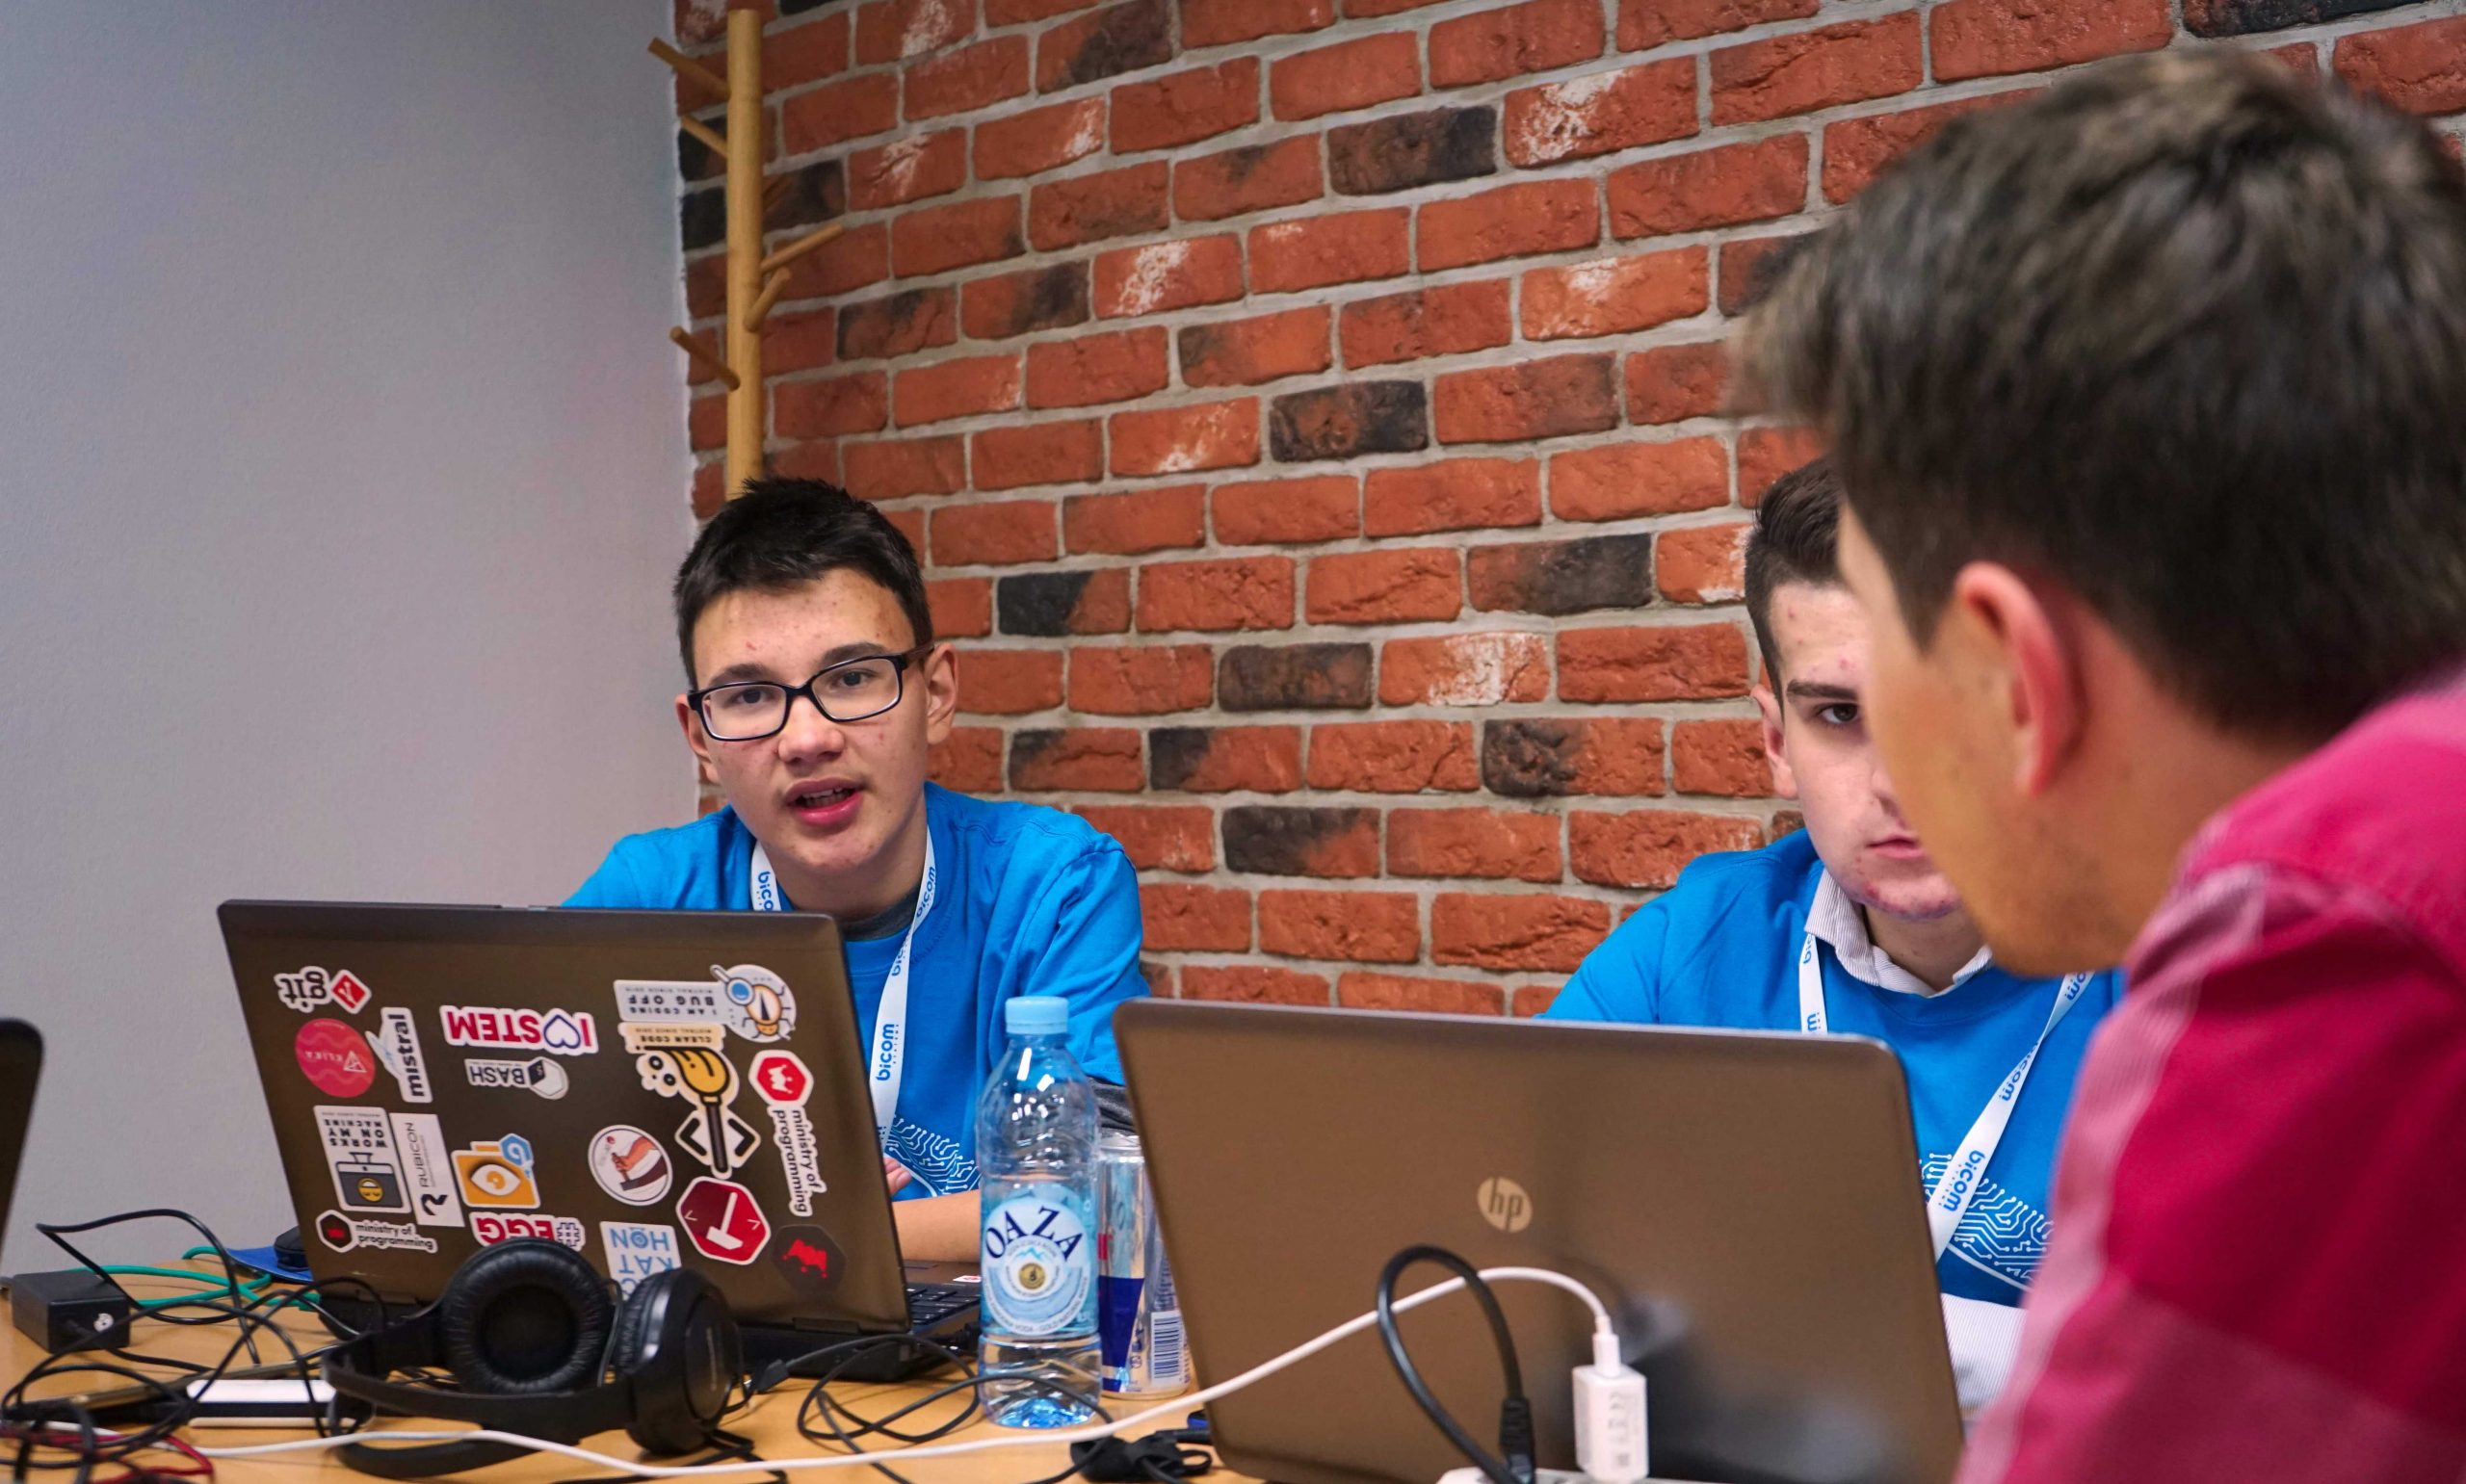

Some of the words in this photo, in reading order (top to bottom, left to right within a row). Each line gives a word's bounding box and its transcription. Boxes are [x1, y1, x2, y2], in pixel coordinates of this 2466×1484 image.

[758, 871, 774, 911] bico
[279, 971, 327, 1008] git
[628, 995, 665, 1005] OFF
[676, 996, 715, 1006] BUG
[447, 1011, 541, 1044] STEM
[387, 1013, 424, 1097] mistral
[876, 1023, 895, 1081] bicom
[469, 1066, 525, 1085] BASH
[328, 1128, 351, 1137] MY
[329, 1138, 387, 1148] WORKS
[361, 1129, 384, 1137] ON
[793, 1109, 814, 1170] ministry
[805, 1172, 822, 1190] of
[405, 1122, 429, 1187] RUBICON
[774, 1109, 808, 1213] programming
[1943, 1150, 1986, 1212] bicom
[1486, 1177, 1526, 1232] hp
[355, 1223, 399, 1237] ministry
[401, 1226, 413, 1236] of
[357, 1235, 433, 1250] programming
[985, 1206, 1084, 1263] OAZA
